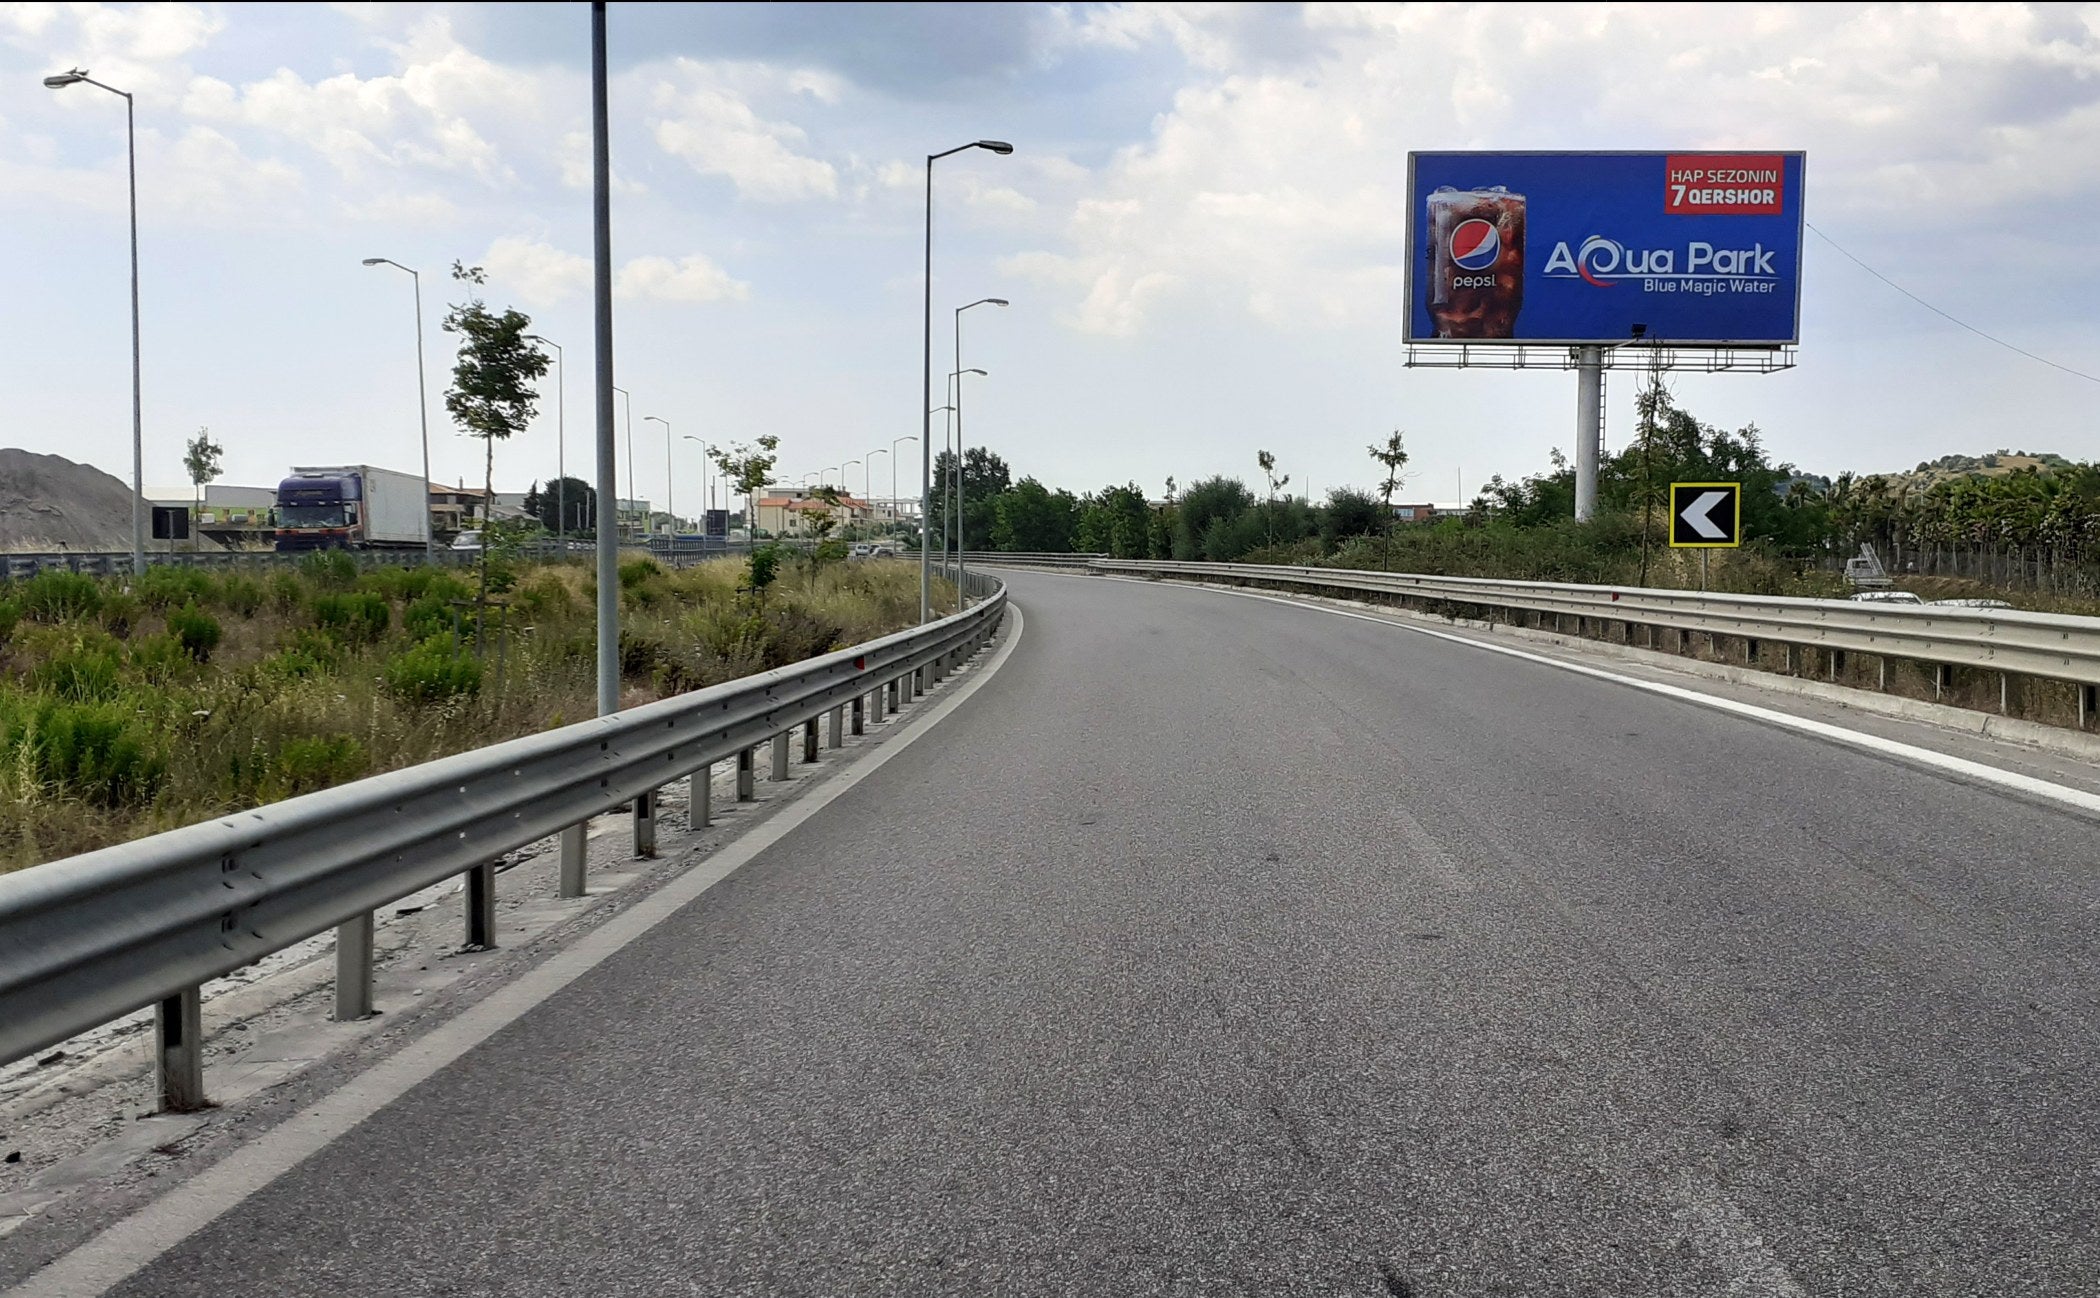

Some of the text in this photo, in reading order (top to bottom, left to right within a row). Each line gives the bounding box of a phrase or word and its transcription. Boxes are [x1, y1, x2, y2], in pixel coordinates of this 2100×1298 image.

[1671, 170, 1777, 183] HAP SEZONIN
[1671, 185, 1775, 206] 7 QERSHOR
[1687, 242, 1776, 274] Park
[1453, 274, 1496, 290] pepsi
[1643, 279, 1776, 296] Blue Magic Water
